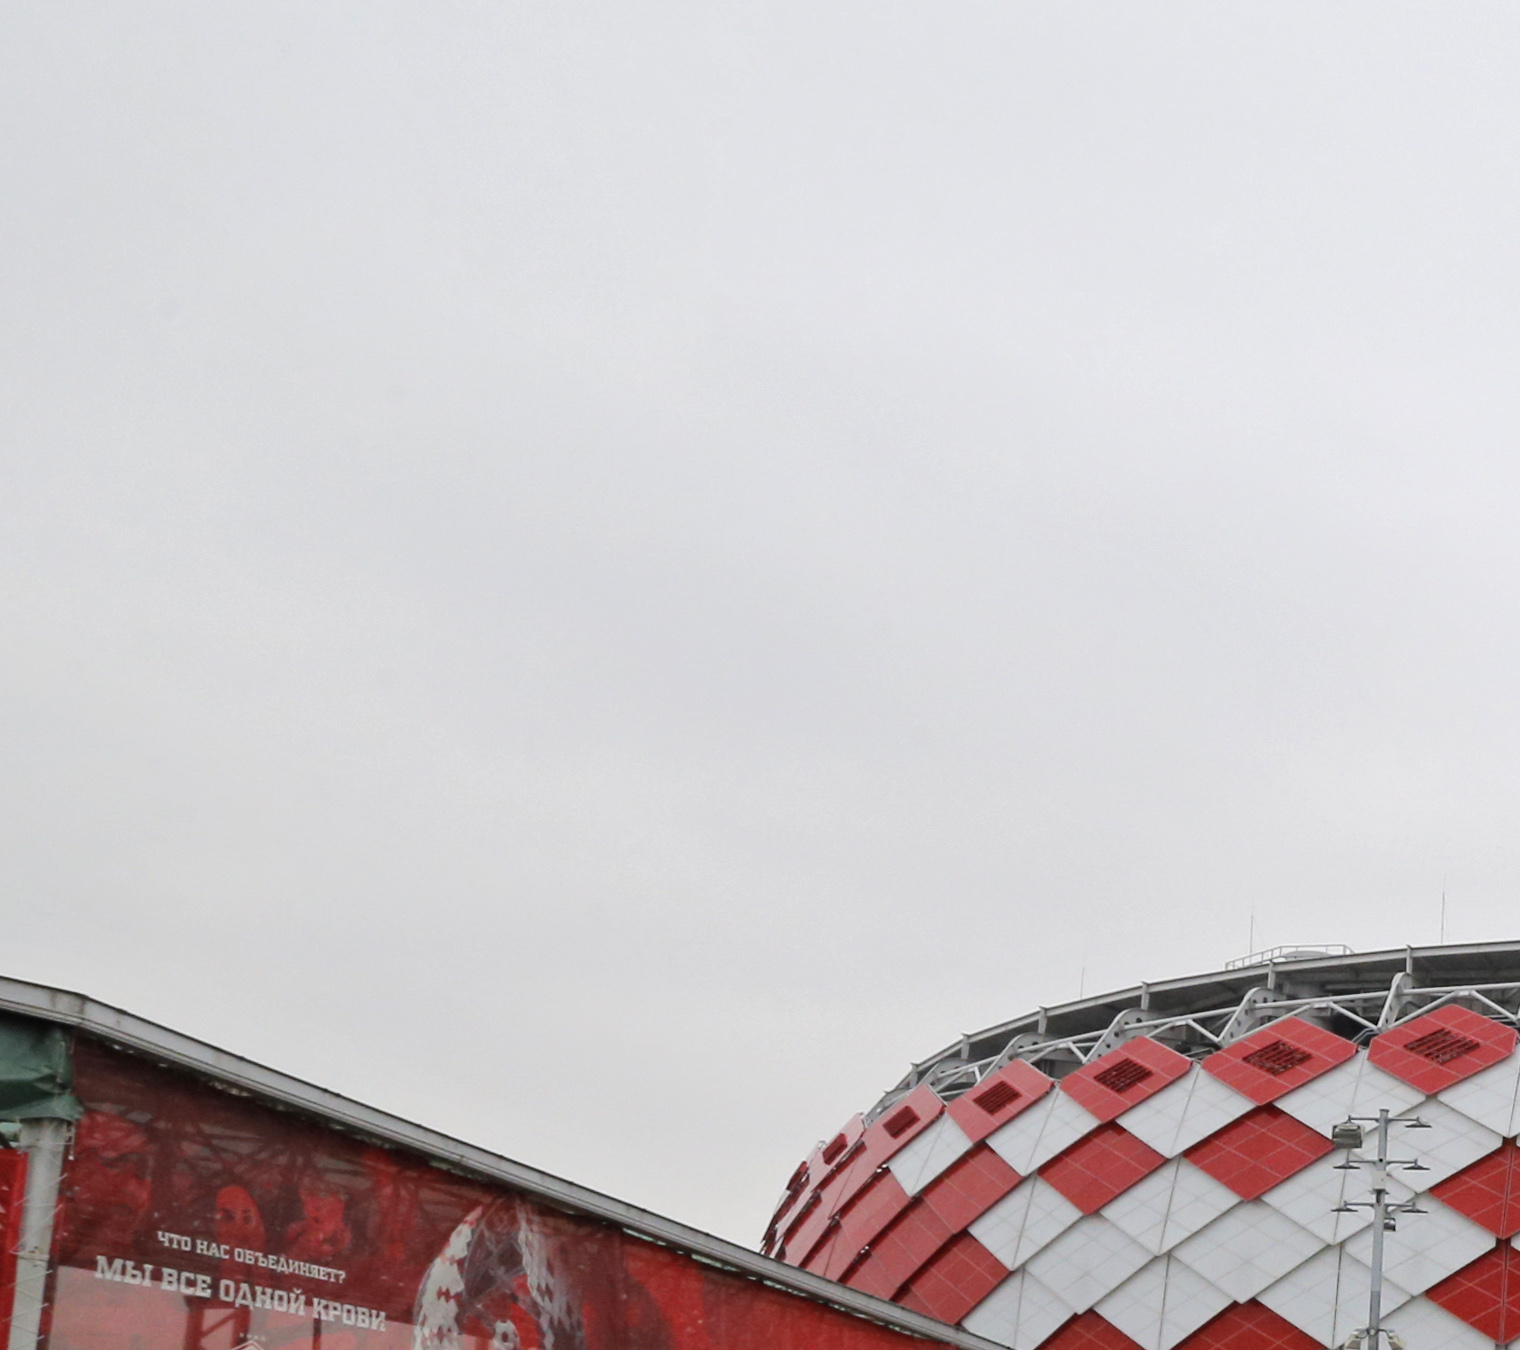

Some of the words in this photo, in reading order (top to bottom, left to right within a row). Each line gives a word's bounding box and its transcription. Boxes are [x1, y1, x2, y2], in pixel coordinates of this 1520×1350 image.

[157, 1231, 191, 1252] ЧТО
[196, 1239, 230, 1260] НАС
[234, 1248, 346, 1284] ОБЪЕДИНЯЕТ?
[94, 1255, 154, 1287] МЫ
[160, 1268, 212, 1298] ВСЕ
[219, 1279, 306, 1316] ОДНОЙ
[312, 1297, 387, 1332] КРОВИ
